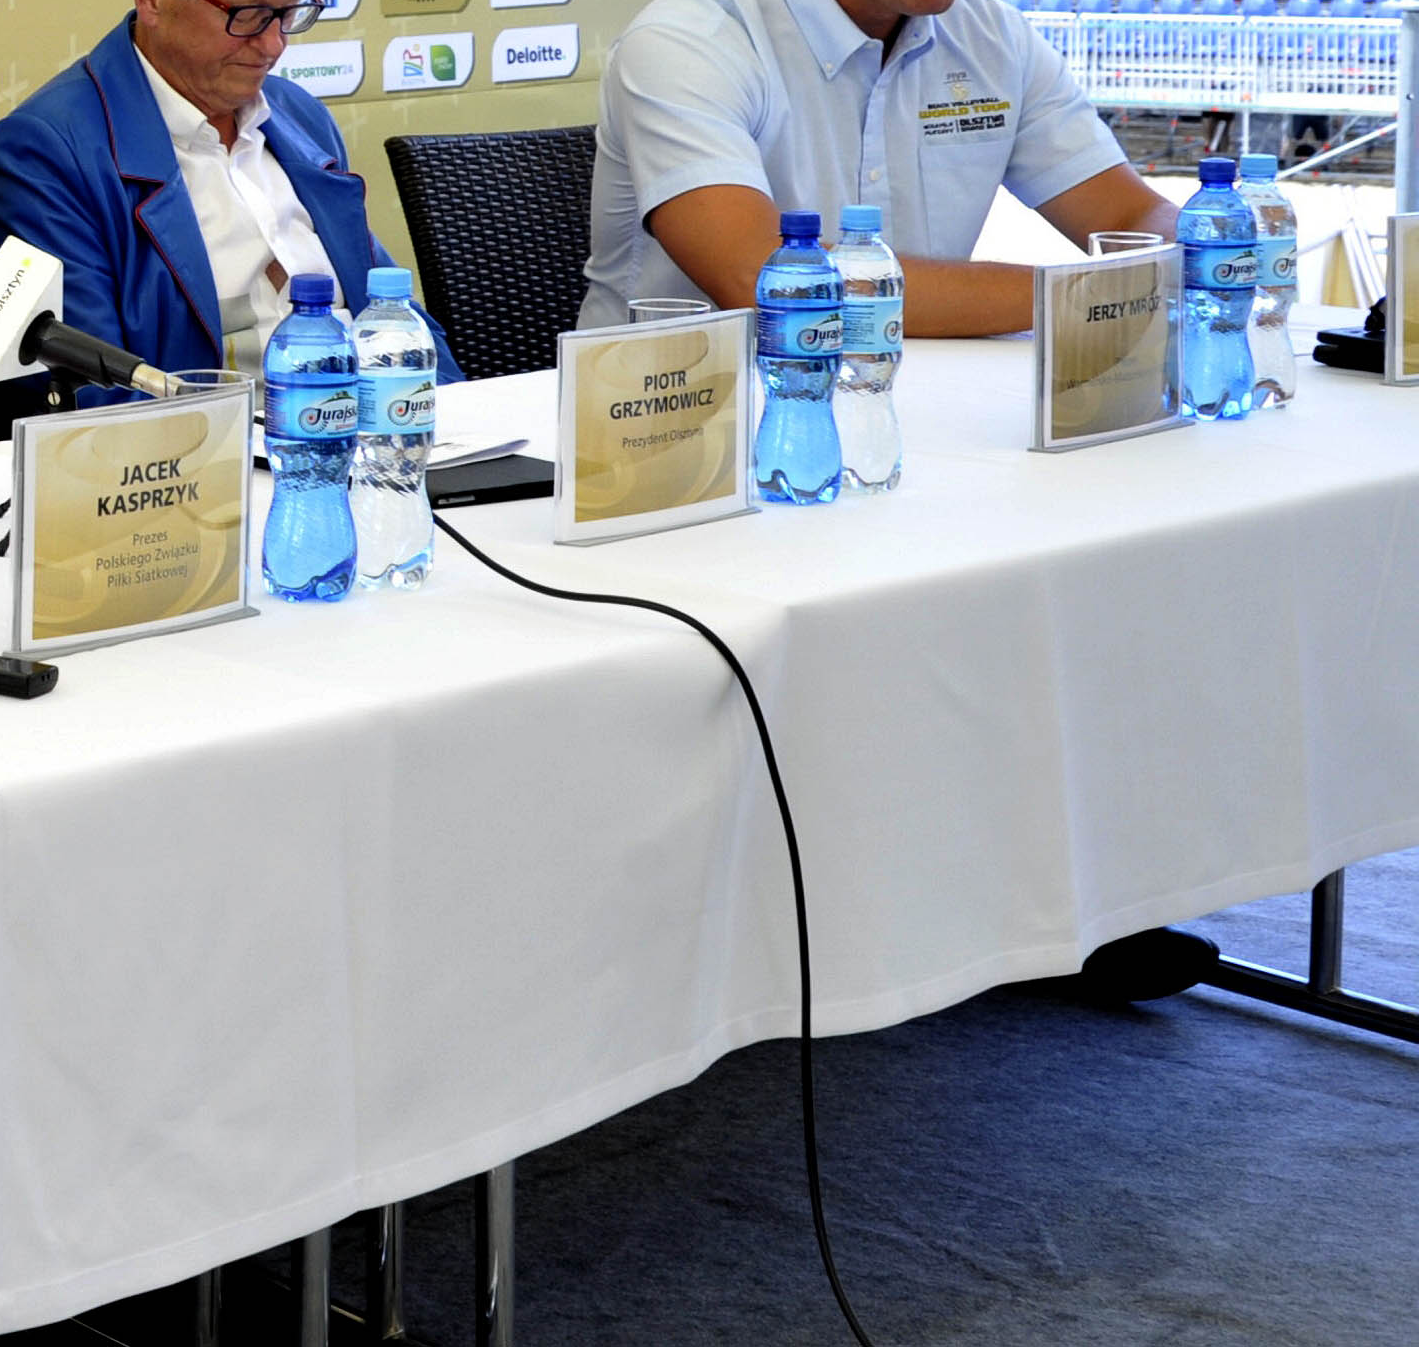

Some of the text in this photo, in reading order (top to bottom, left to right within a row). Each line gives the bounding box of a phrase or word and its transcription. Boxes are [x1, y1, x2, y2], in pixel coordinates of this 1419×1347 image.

[1087, 302, 1125, 322] JERZY
[644, 370, 686, 392] PIOTR
[610, 388, 713, 420] GRZYMOWICZ
[120, 458, 181, 486] JACEK
[98, 481, 200, 517] KASPRZYK
[132, 529, 168, 547] Prezes
[96, 542, 199, 571] Polskiego Związku
[135, 564, 188, 586] Siatkowej
